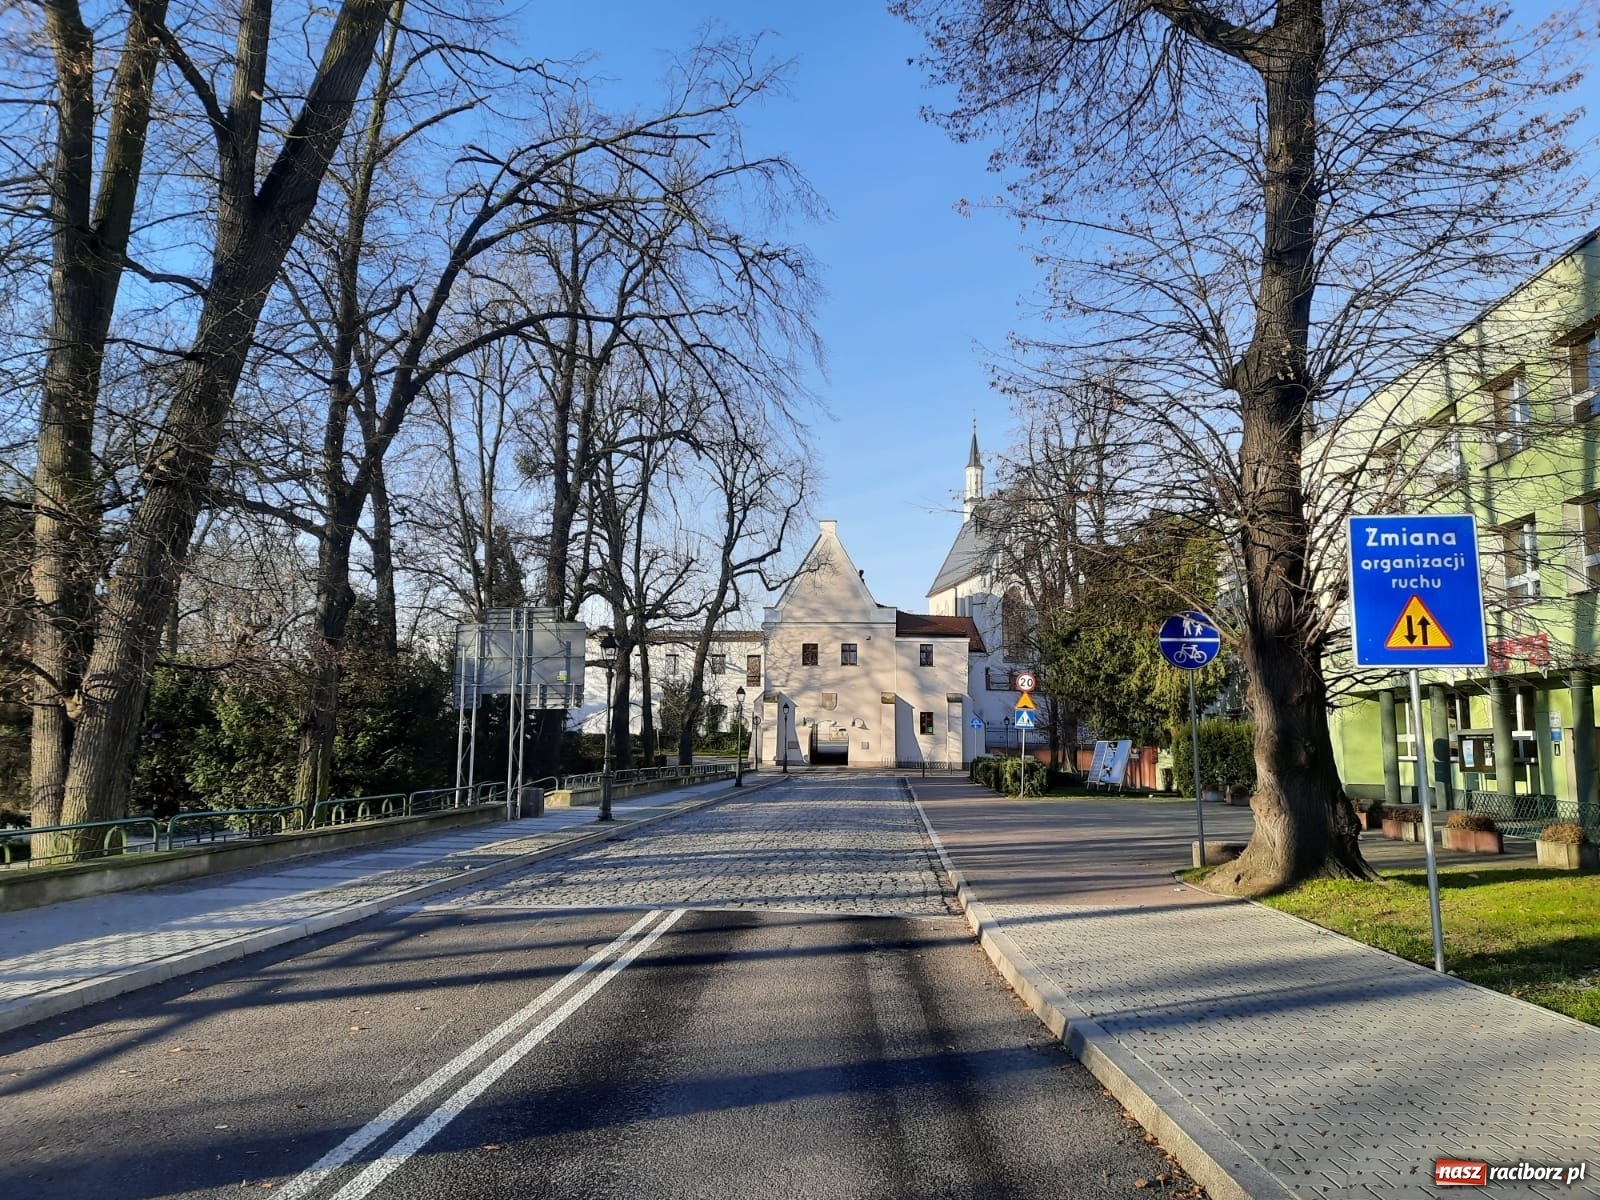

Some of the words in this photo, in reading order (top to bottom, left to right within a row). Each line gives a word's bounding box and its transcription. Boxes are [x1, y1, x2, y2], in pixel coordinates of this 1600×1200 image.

[1365, 527, 1457, 547] Zmiana
[1361, 553, 1465, 573] organizacji
[1391, 574, 1442, 589] ruchu
[1020, 678, 1033, 687] 20
